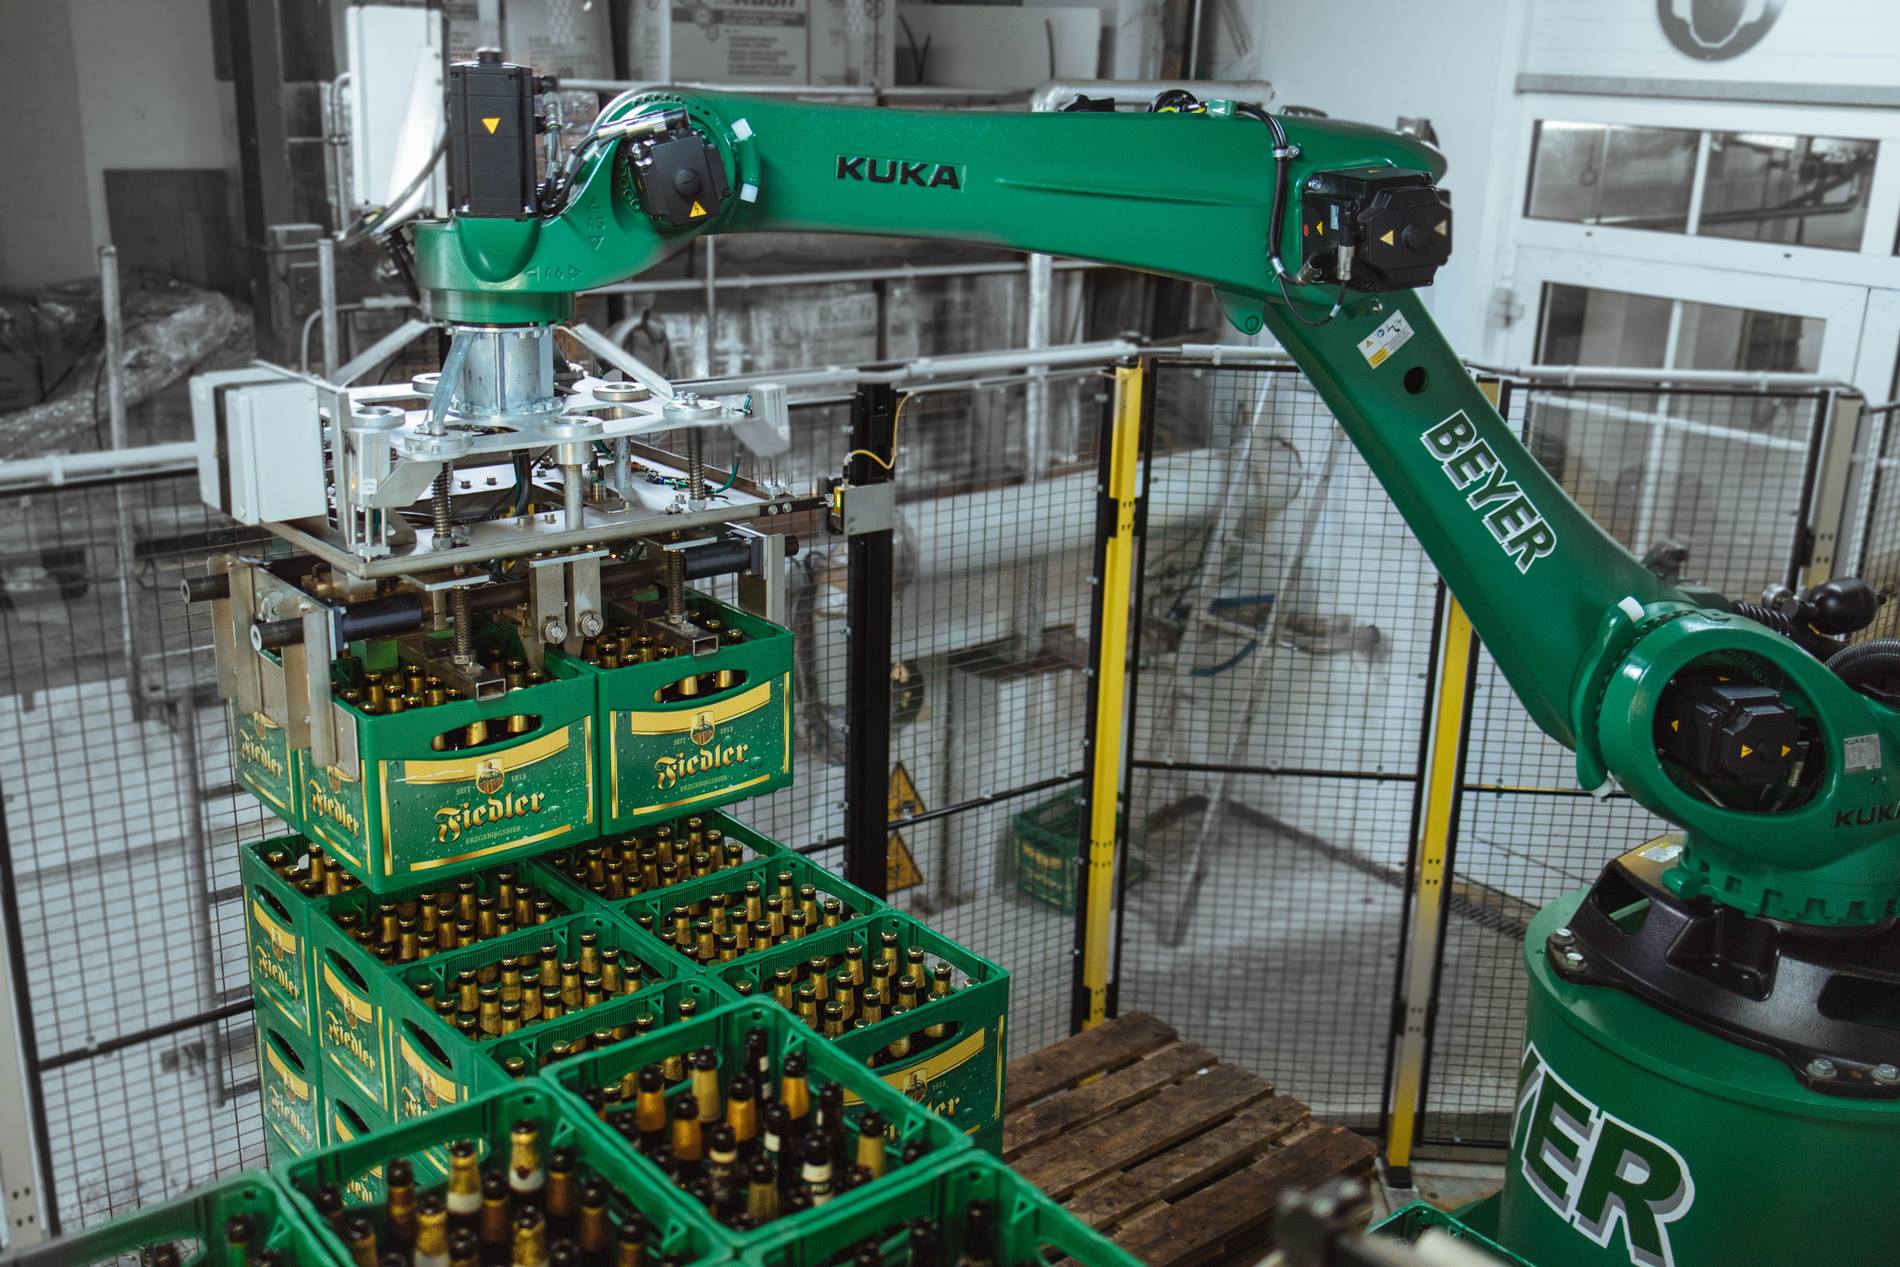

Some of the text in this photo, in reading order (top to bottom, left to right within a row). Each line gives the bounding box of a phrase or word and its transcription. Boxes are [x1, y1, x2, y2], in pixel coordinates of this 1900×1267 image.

[836, 154, 961, 190] KUKA
[1420, 409, 1557, 576] BEYER
[239, 728, 283, 782] Fiedler
[654, 743, 750, 791] Fiedler
[309, 779, 360, 838] Fiedler
[433, 791, 546, 844] Fiedler
[456, 785, 472, 796] SEIT
[256, 944, 300, 1002] Fiedler
[325, 1009, 376, 1075] Fiedler
